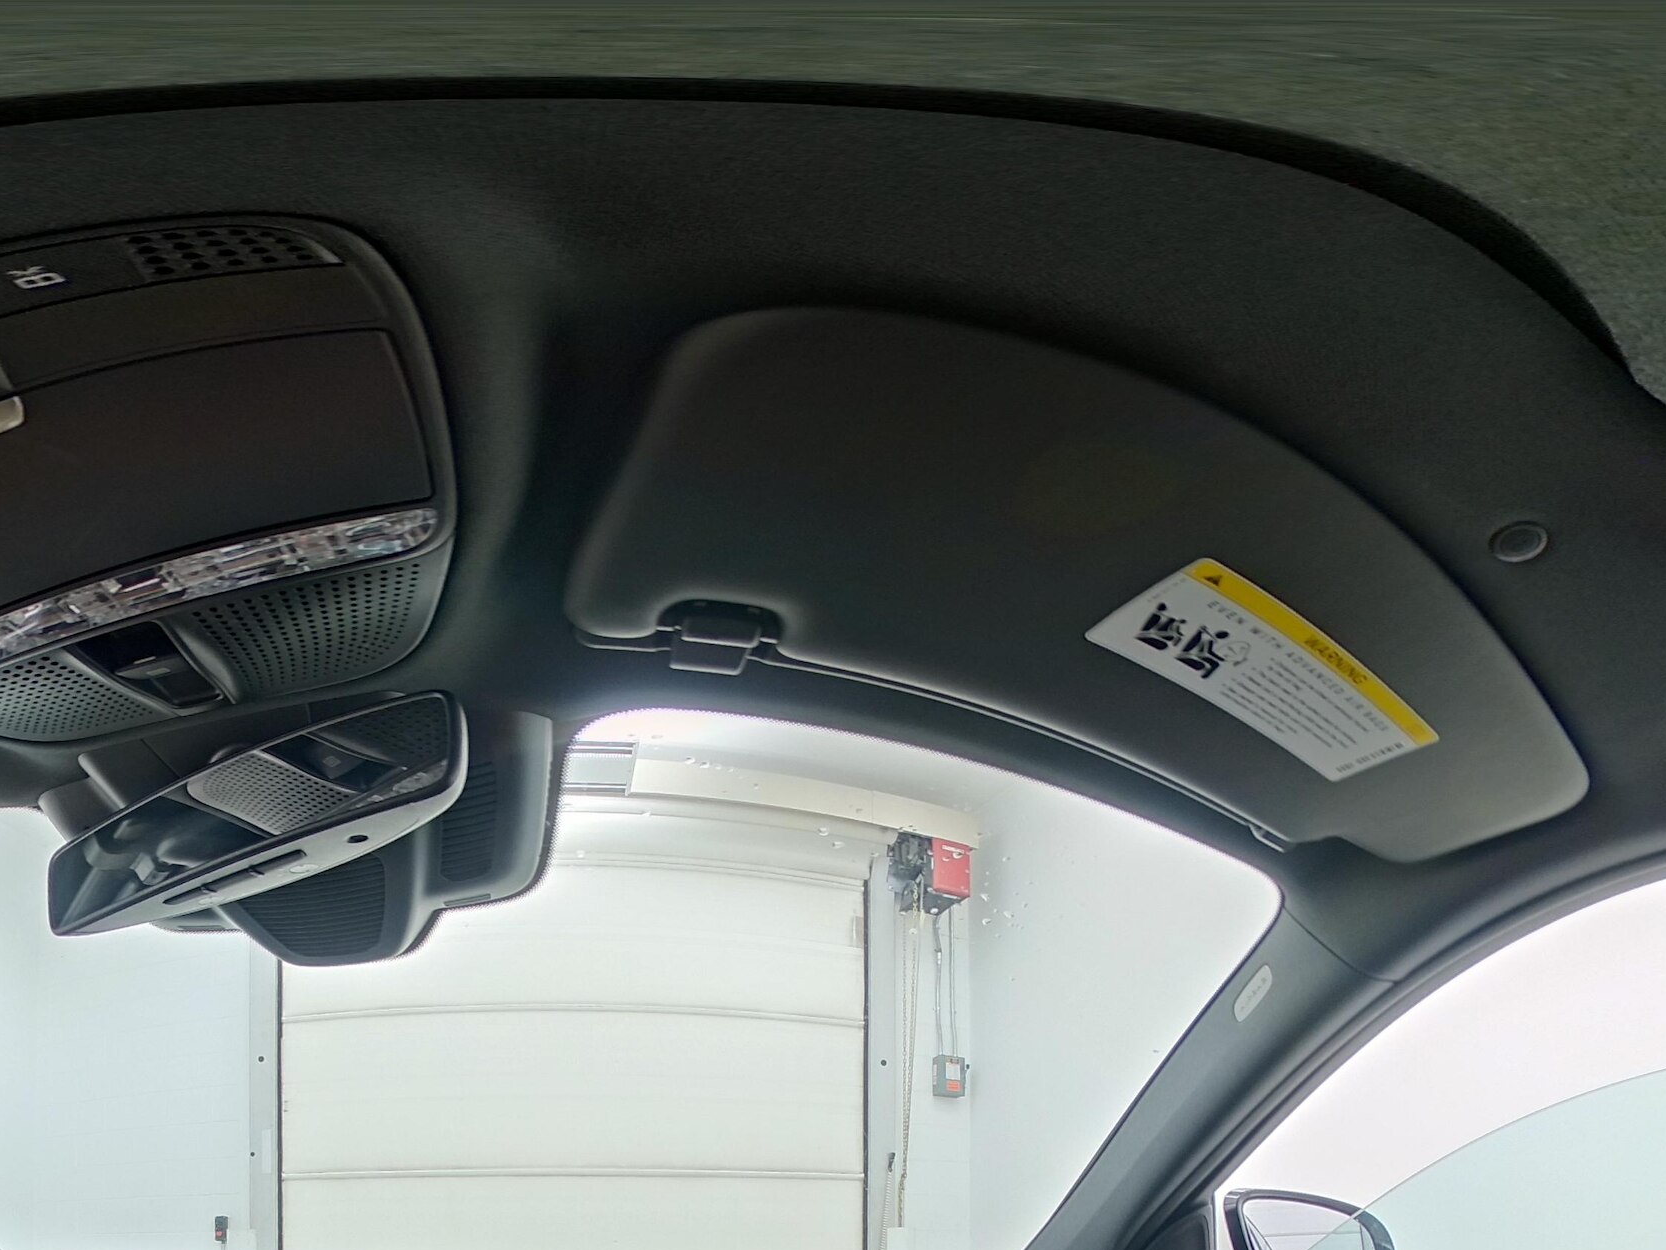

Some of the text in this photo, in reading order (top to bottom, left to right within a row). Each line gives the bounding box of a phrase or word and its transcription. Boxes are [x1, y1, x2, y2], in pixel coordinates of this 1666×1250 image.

[1207, 600, 1245, 625] EVEN
[1249, 626, 1282, 649] WITH
[1285, 651, 1345, 695] ADVANCED
[1303, 635, 1368, 685] WARNING
